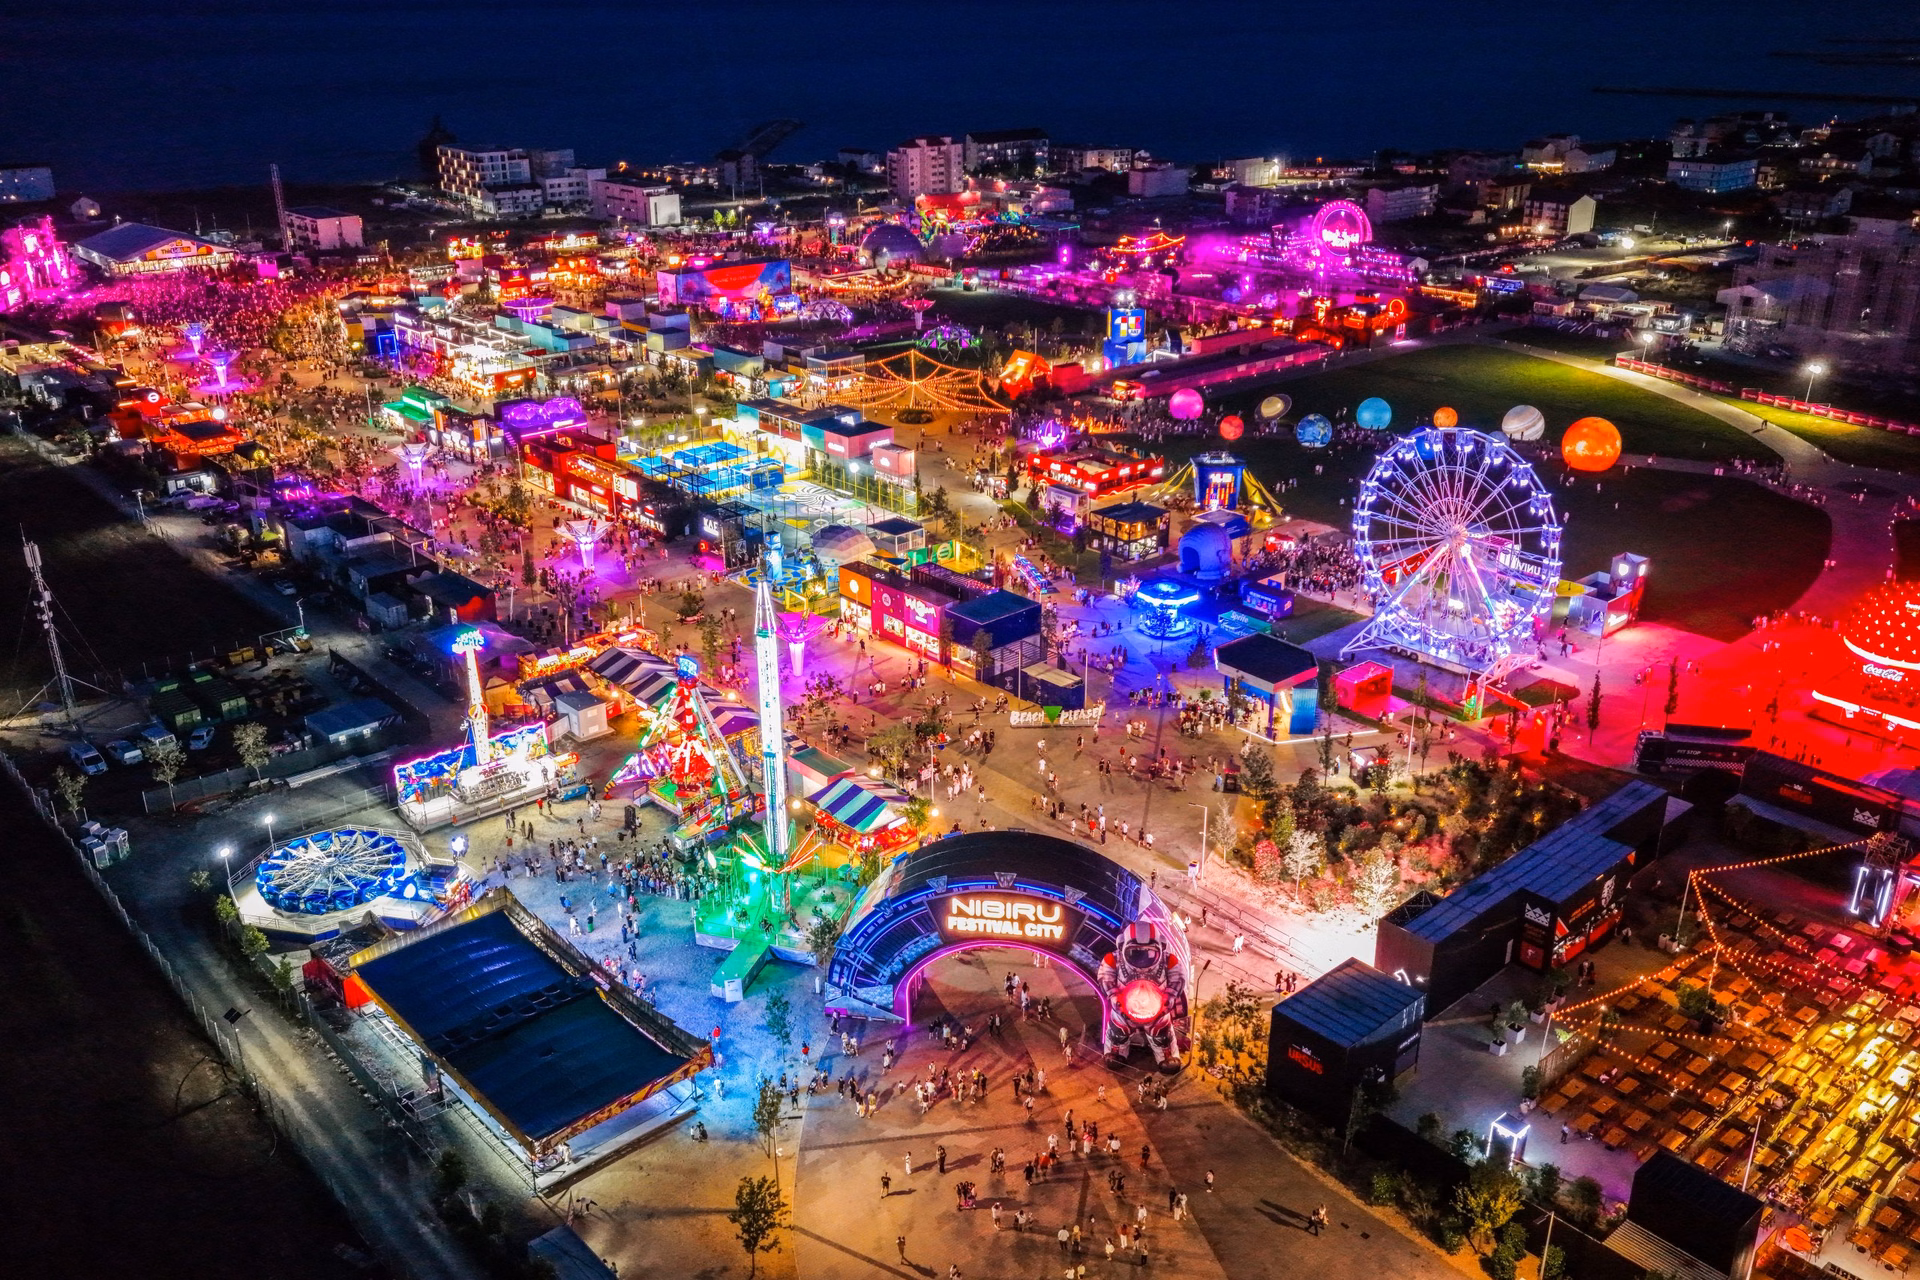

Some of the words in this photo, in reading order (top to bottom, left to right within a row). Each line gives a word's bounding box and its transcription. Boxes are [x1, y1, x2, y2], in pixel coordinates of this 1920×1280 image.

[1009, 710, 1045, 726] BEACH
[1060, 704, 1104, 726] PLEASE!
[951, 897, 1061, 923] NIBIRU
[947, 915, 1023, 936] FESTIVAL
[1024, 922, 1064, 939] CITY
[1287, 1046, 1323, 1075] URSUS
